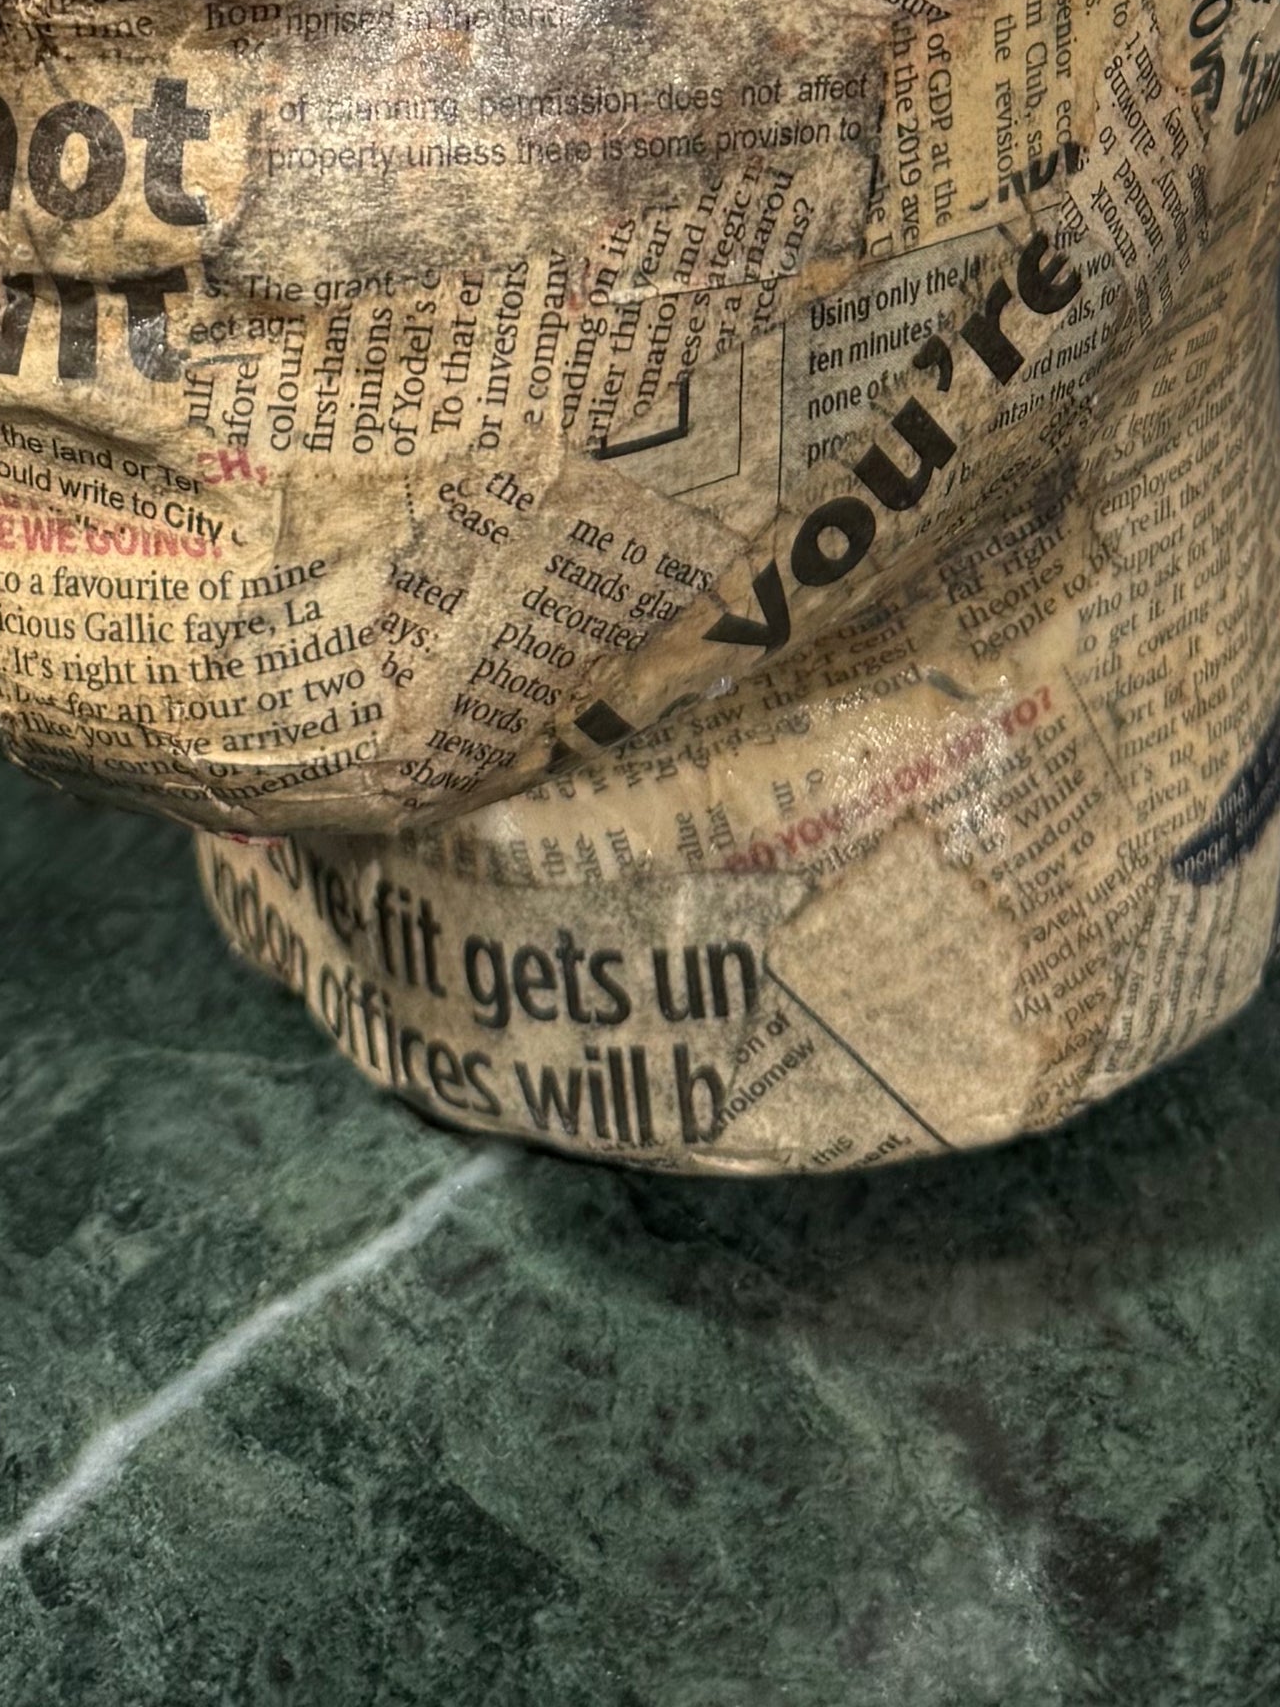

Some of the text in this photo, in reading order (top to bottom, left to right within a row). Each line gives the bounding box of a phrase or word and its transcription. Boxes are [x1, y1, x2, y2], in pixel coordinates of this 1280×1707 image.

[279, 93, 310, 123] of
[656, 83, 724, 112] does
[740, 78, 783, 108] not
[797, 72, 869, 103] affect
[1024, 40, 1048, 118] Club,
[1098, 55, 1157, 158] allowing to
[270, 141, 396, 179] property
[406, 139, 507, 168] unless
[601, 133, 624, 161] is
[632, 133, 708, 160] some
[717, 120, 831, 161] provision
[839, 116, 863, 142] to
[894, 67, 922, 187] the 2019
[926, 32, 958, 229] of GDP at the
[1089, 179, 1138, 268] artwork
[1112, 156, 1165, 254] intended
[247, 273, 398, 309] The grant
[809, 265, 959, 332] Using only the
[351, 306, 394, 455] opinions
[388, 298, 438, 457] of Yodel's
[430, 313, 479, 435] To that
[476, 259, 531, 450] or investors
[808, 319, 933, 376] ten minutes
[1056, 339, 1099, 372] must
[703, 229, 1083, 655] you're
[58, 476, 126, 511] write
[131, 496, 158, 520] to
[164, 502, 225, 544] City
[484, 470, 536, 513] the
[1099, 453, 1194, 520] employees
[29, 572, 45, 596] a
[53, 566, 191, 601] favourite
[199, 569, 235, 601] of
[241, 558, 328, 600] mine
[567, 517, 715, 594] me to tears.
[84, 611, 174, 643] Gallic
[184, 612, 277, 650] fayre,
[284, 599, 325, 629] La
[521, 585, 650, 653] decorated
[954, 557, 1066, 631] theories
[970, 572, 1087, 666] people to
[1077, 592, 1121, 626] who
[1129, 576, 1151, 604] to
[1152, 556, 1183, 590] ask
[13, 622, 376, 691] It's right in the middle
[491, 621, 577, 671] photo
[824, 637, 919, 688] largest
[1136, 601, 1210, 659] covering
[117, 703, 156, 724] an
[257, 689, 294, 714] or
[303, 666, 366, 704] two
[380, 651, 416, 689] be
[469, 655, 564, 708] photos
[450, 692, 529, 736] words
[989, 787, 1103, 883] standouts
[1115, 794, 1208, 860] currently
[463, 928, 630, 1029] gets
[513, 1043, 655, 1146] will
